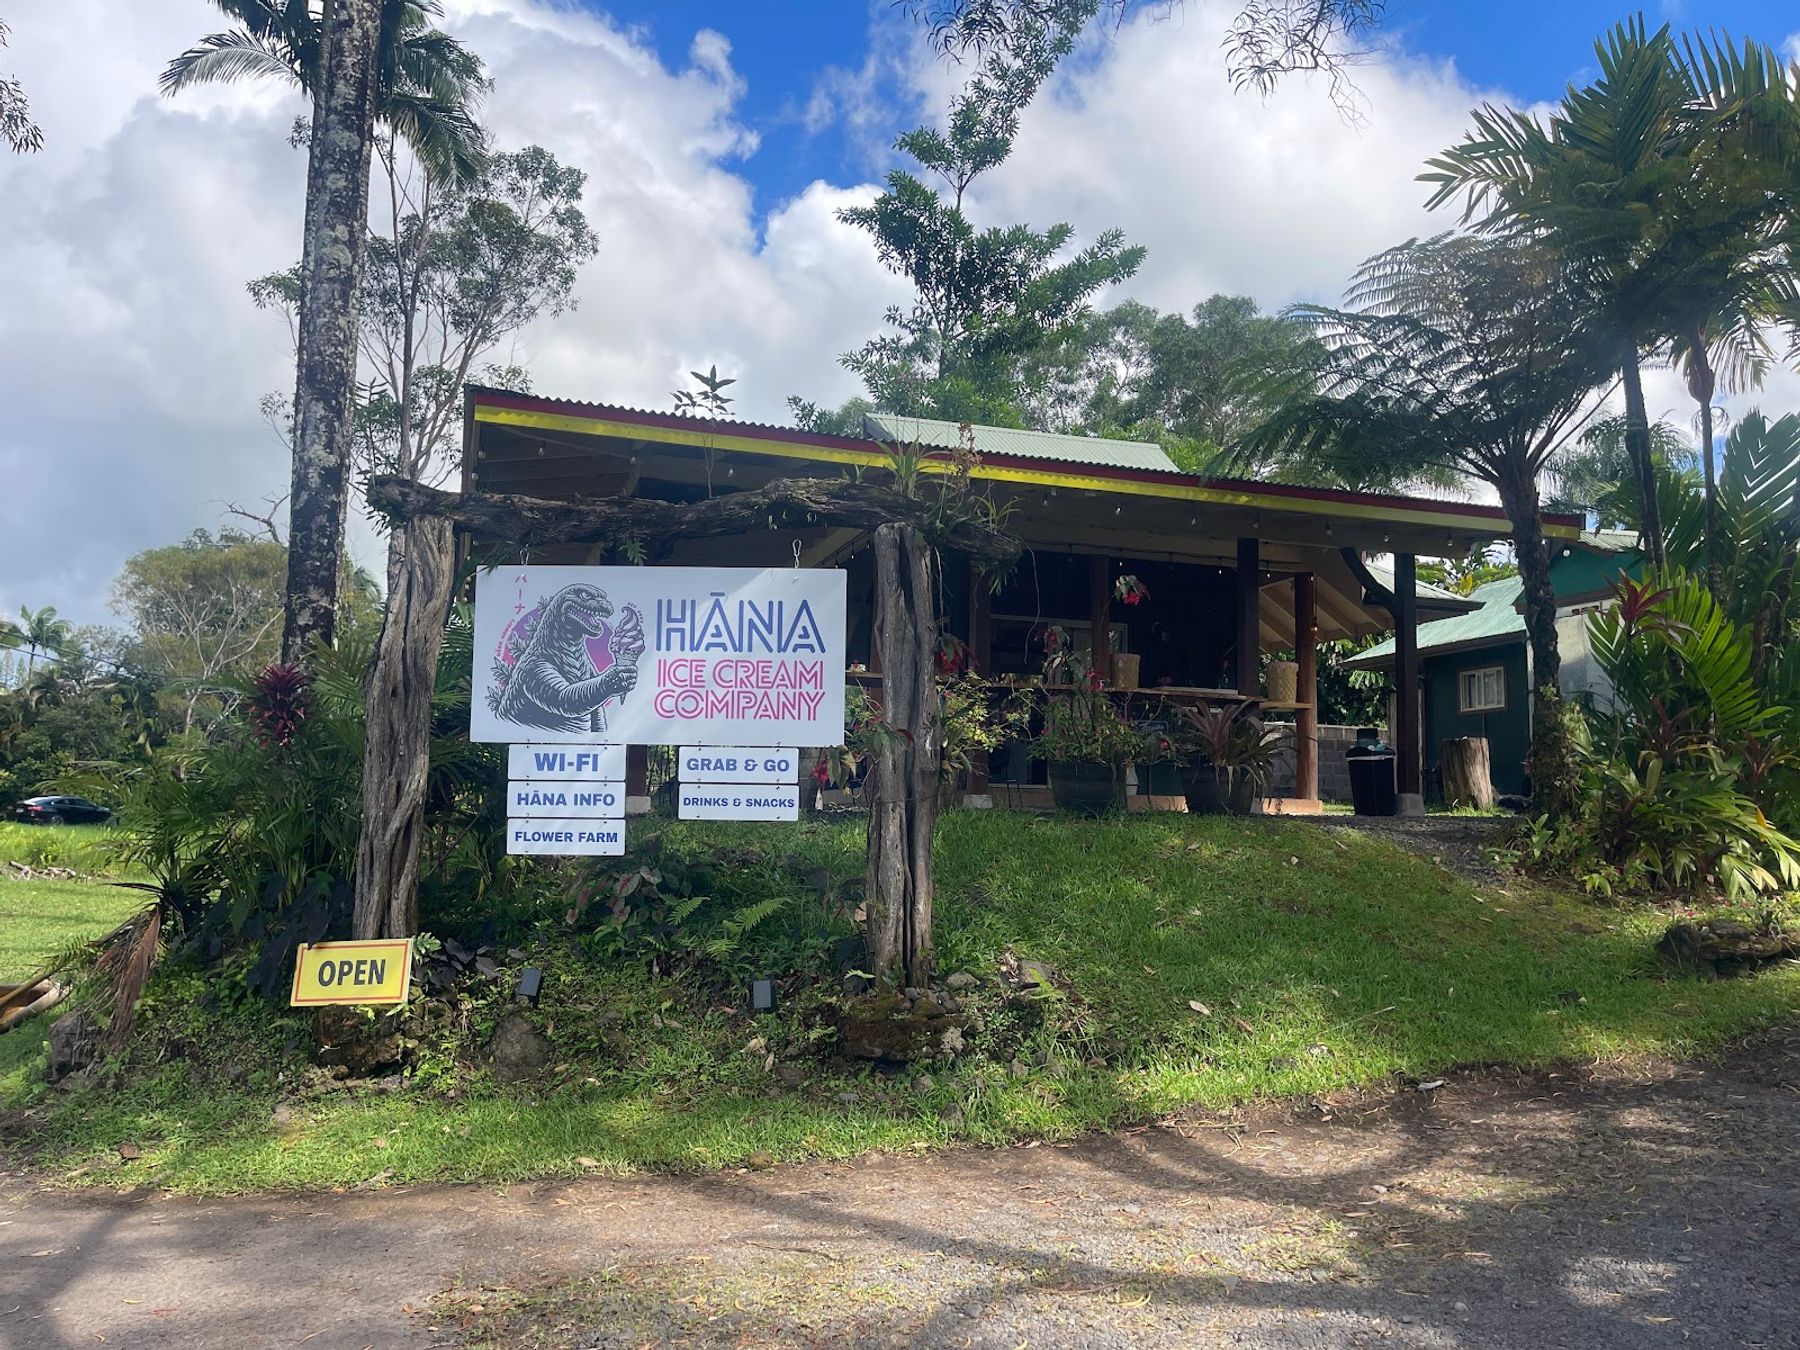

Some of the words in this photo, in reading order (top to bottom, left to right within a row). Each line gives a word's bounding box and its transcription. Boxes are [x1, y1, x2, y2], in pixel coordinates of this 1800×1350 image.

[656, 591, 826, 654] HĀNA
[657, 658, 706, 689] ICE
[712, 659, 824, 690] CREAM
[654, 689, 826, 721] COMPANY
[534, 753, 599, 772] WI-FI
[686, 758, 737, 771] GRAB
[743, 759, 758, 772] &
[763, 759, 790, 772] GO
[517, 789, 567, 806] HĀNA
[573, 793, 616, 806] INFO
[683, 797, 729, 807] DRINKS
[732, 798, 743, 807] &
[745, 798, 795, 808] SNACKS
[515, 831, 573, 842] FLOWER
[578, 832, 618, 843] FARM
[318, 959, 386, 987] OPEN
